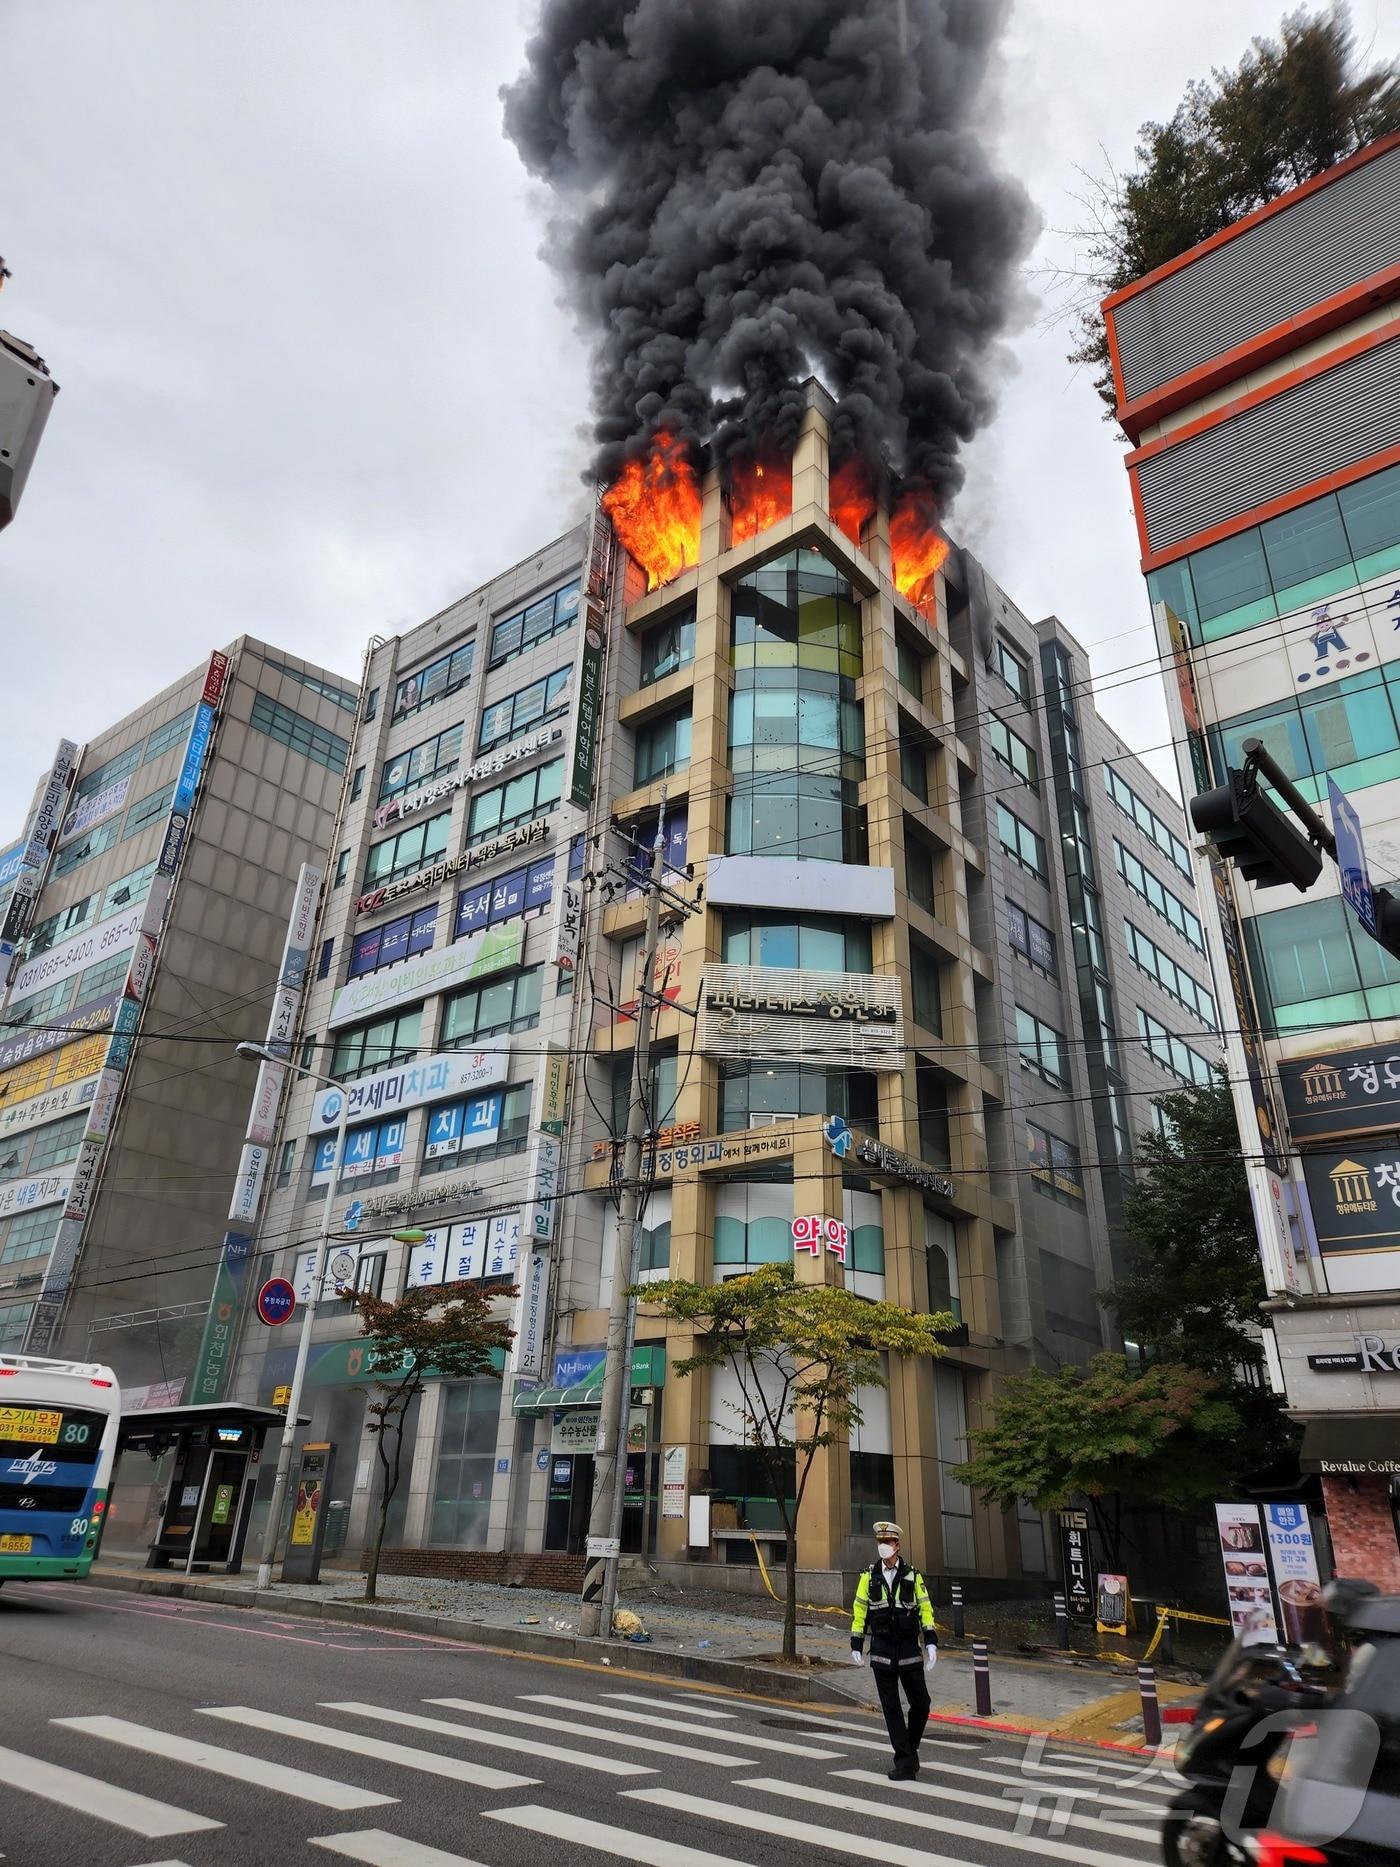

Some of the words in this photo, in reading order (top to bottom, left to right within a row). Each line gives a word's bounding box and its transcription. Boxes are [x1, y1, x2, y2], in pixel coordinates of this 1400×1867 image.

[353, 886, 387, 916] TOZ
[385, 879, 412, 901] 토즈
[412, 851, 471, 890] 스터디센터
[502, 819, 548, 851] 독서실
[460, 886, 509, 920] 독서실
[563, 886, 580, 939] 한복
[277, 995, 295, 1039] 독서실
[711, 984, 817, 1032] 필라테스
[816, 988, 870, 1021] 정원
[873, 1003, 896, 1017] 3F
[471, 1053, 486, 1070] 3F
[347, 1060, 449, 1116] 연세미치과
[436, 1098, 497, 1139] 치과
[743, 1138, 791, 1157] 함께하세요!
[227, 1243, 247, 1256] NH
[458, 1225, 477, 1277] 관절
[491, 1218, 508, 1273] 비수술
[791, 1215, 823, 1257] 약
[824, 1218, 848, 1264] 약
[526, 1265, 543, 1354] 올바른정형외과
[523, 1354, 536, 1368] 2F
[557, 1362, 577, 1375] NH
[64, 1423, 89, 1444] 80
[1320, 1460, 1366, 1473] Revalue
[70, 1518, 88, 1535] 80
[1277, 1507, 1294, 1517] 매일
[1270, 1532, 1313, 1546] 1300원
[1068, 1530, 1086, 1595] 휘트니스
